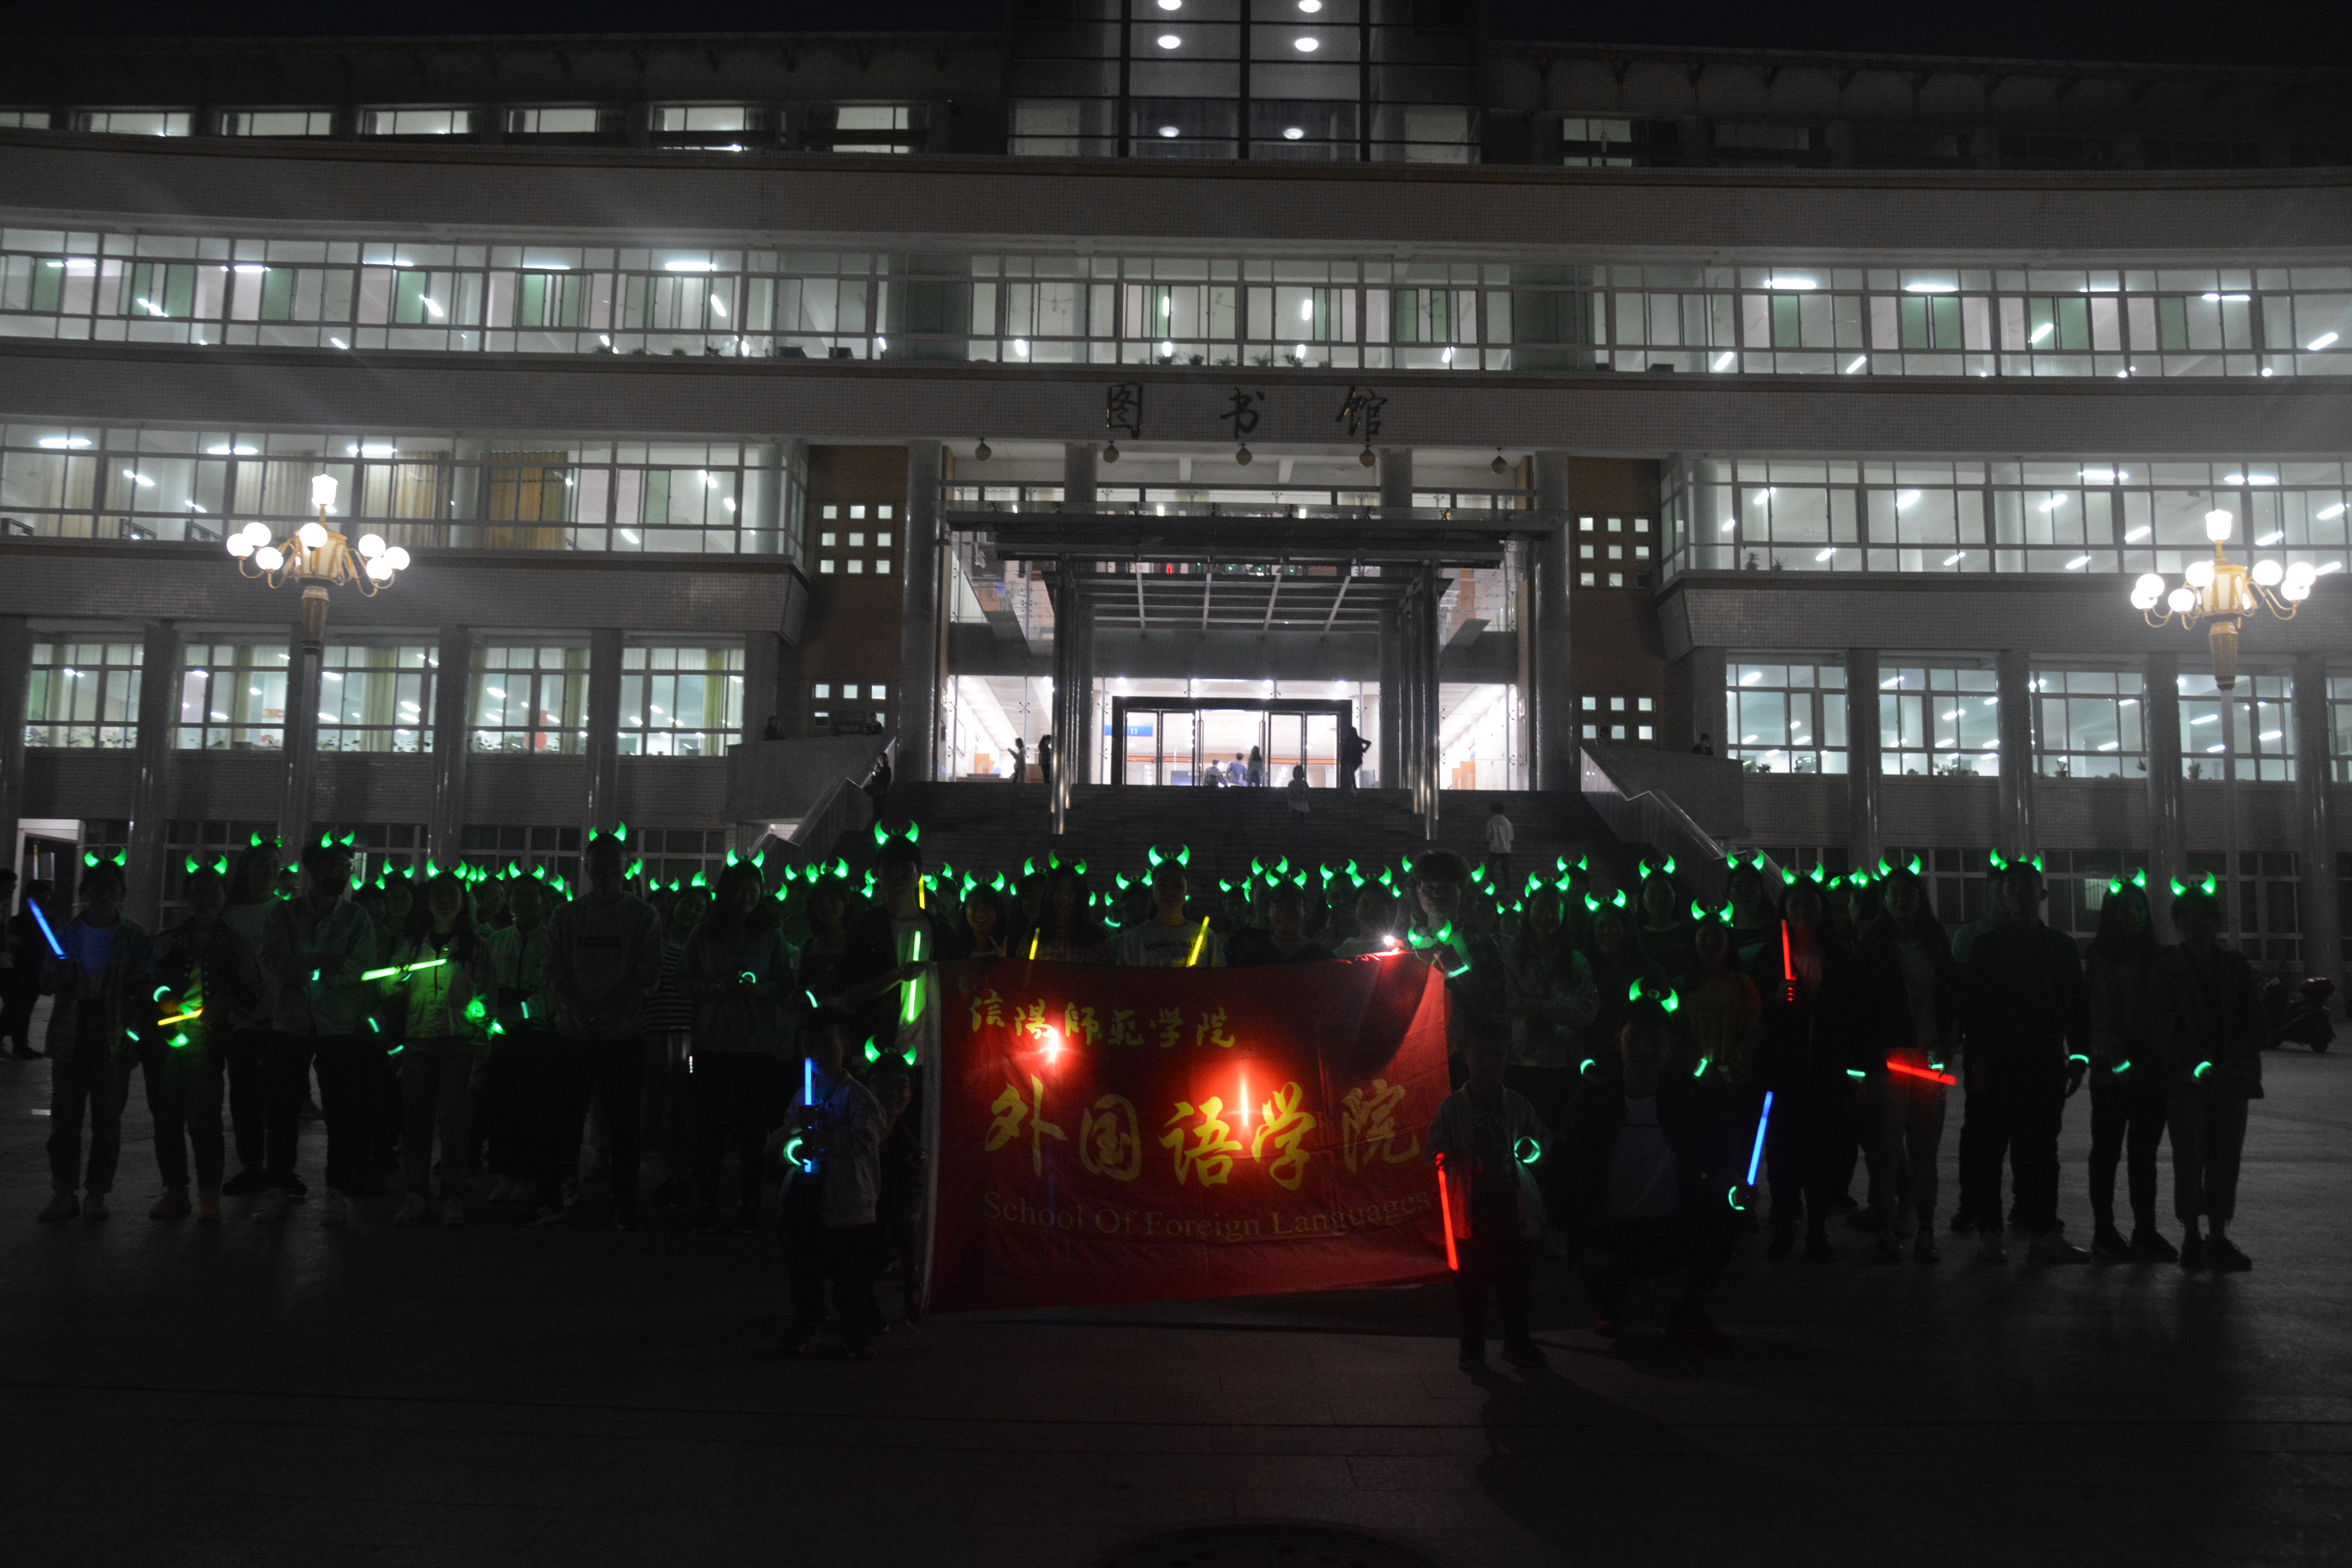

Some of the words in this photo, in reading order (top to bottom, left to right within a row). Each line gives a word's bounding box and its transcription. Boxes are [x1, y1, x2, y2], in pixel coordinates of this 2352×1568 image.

[1106, 382, 1388, 442] 图书馆
[1144, 941, 1177, 954] HUMAN
[983, 1191, 1083, 1230] School
[1094, 1208, 1138, 1234] Of
[1143, 1211, 1261, 1242] Foreign
[1271, 1191, 1430, 1236] Languages
